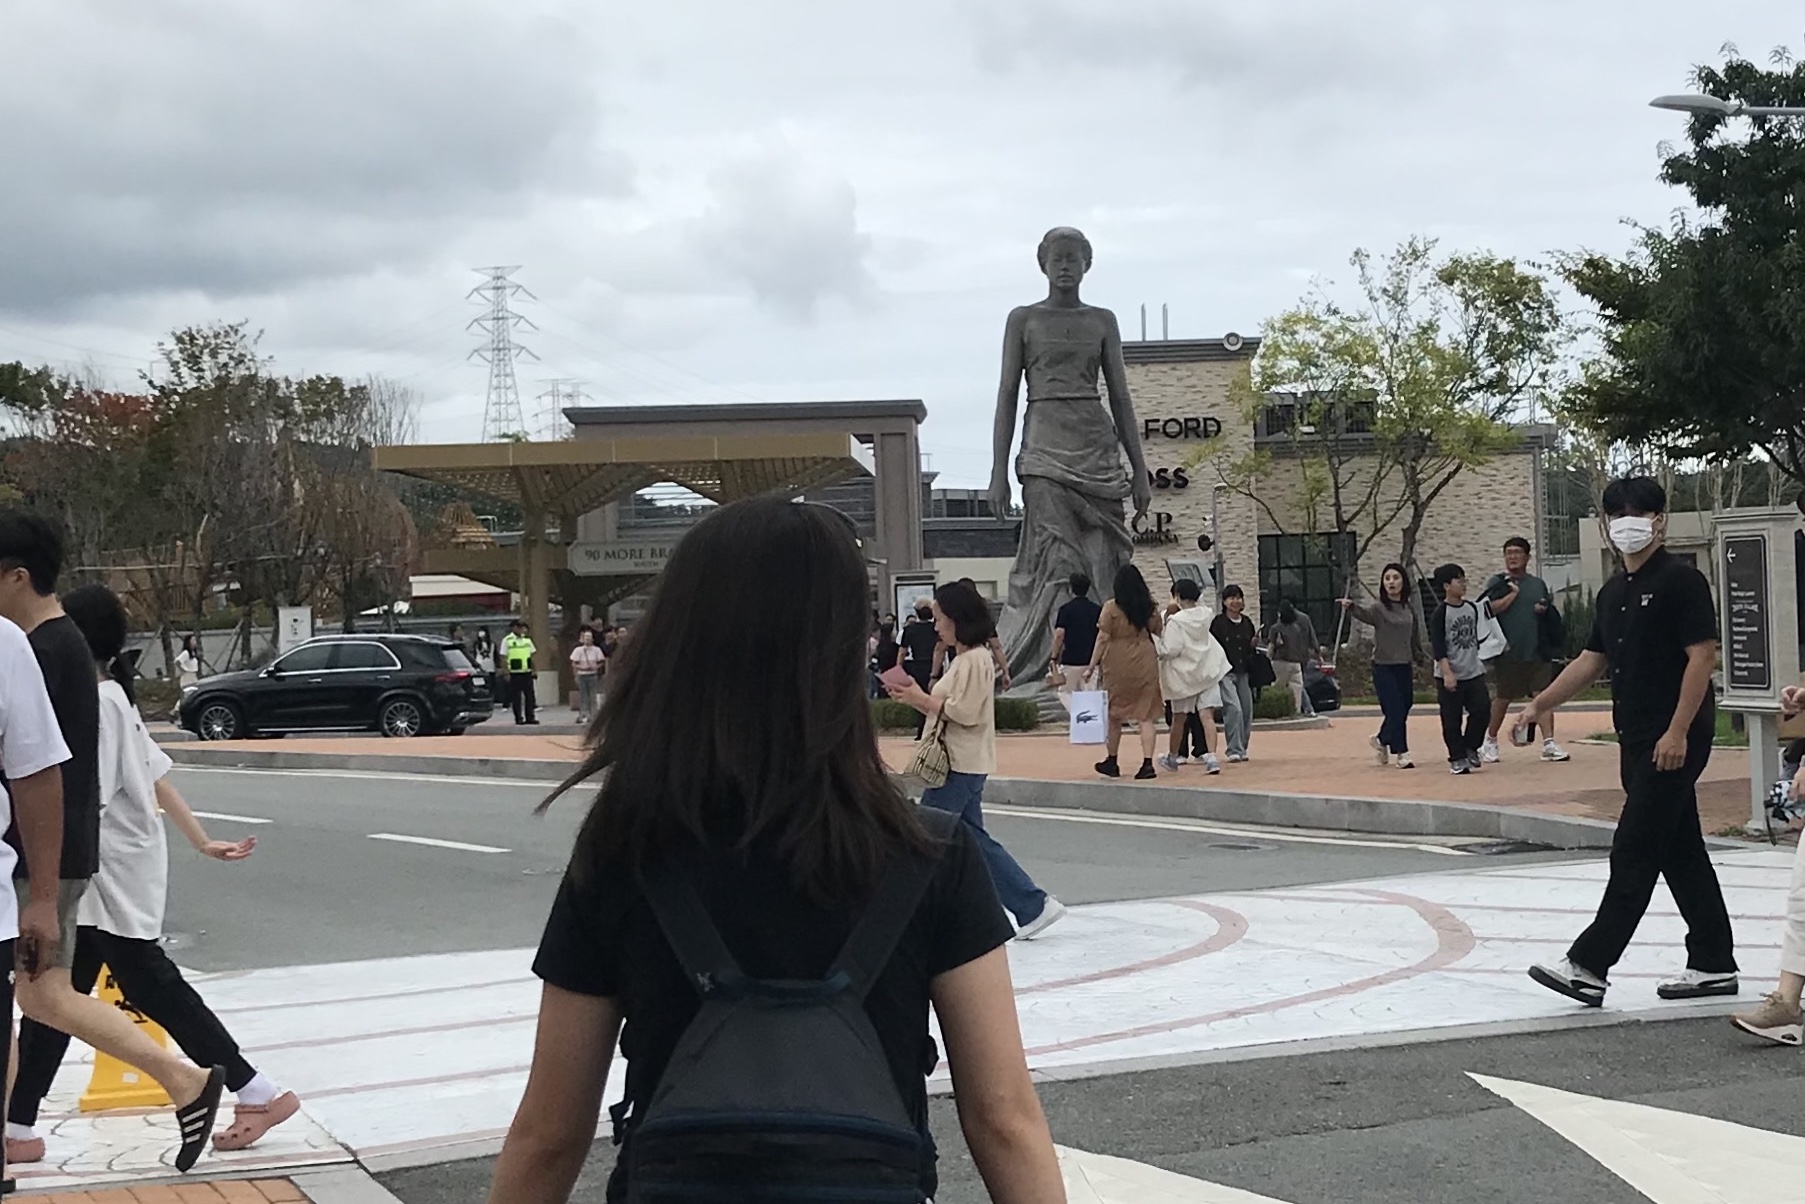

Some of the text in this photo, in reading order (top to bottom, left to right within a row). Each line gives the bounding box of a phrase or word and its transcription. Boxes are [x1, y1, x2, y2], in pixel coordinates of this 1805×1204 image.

[1144, 417, 1222, 440] FORD
[1147, 466, 1190, 489] SS
[584, 547, 674, 561] 90 MORE BR
